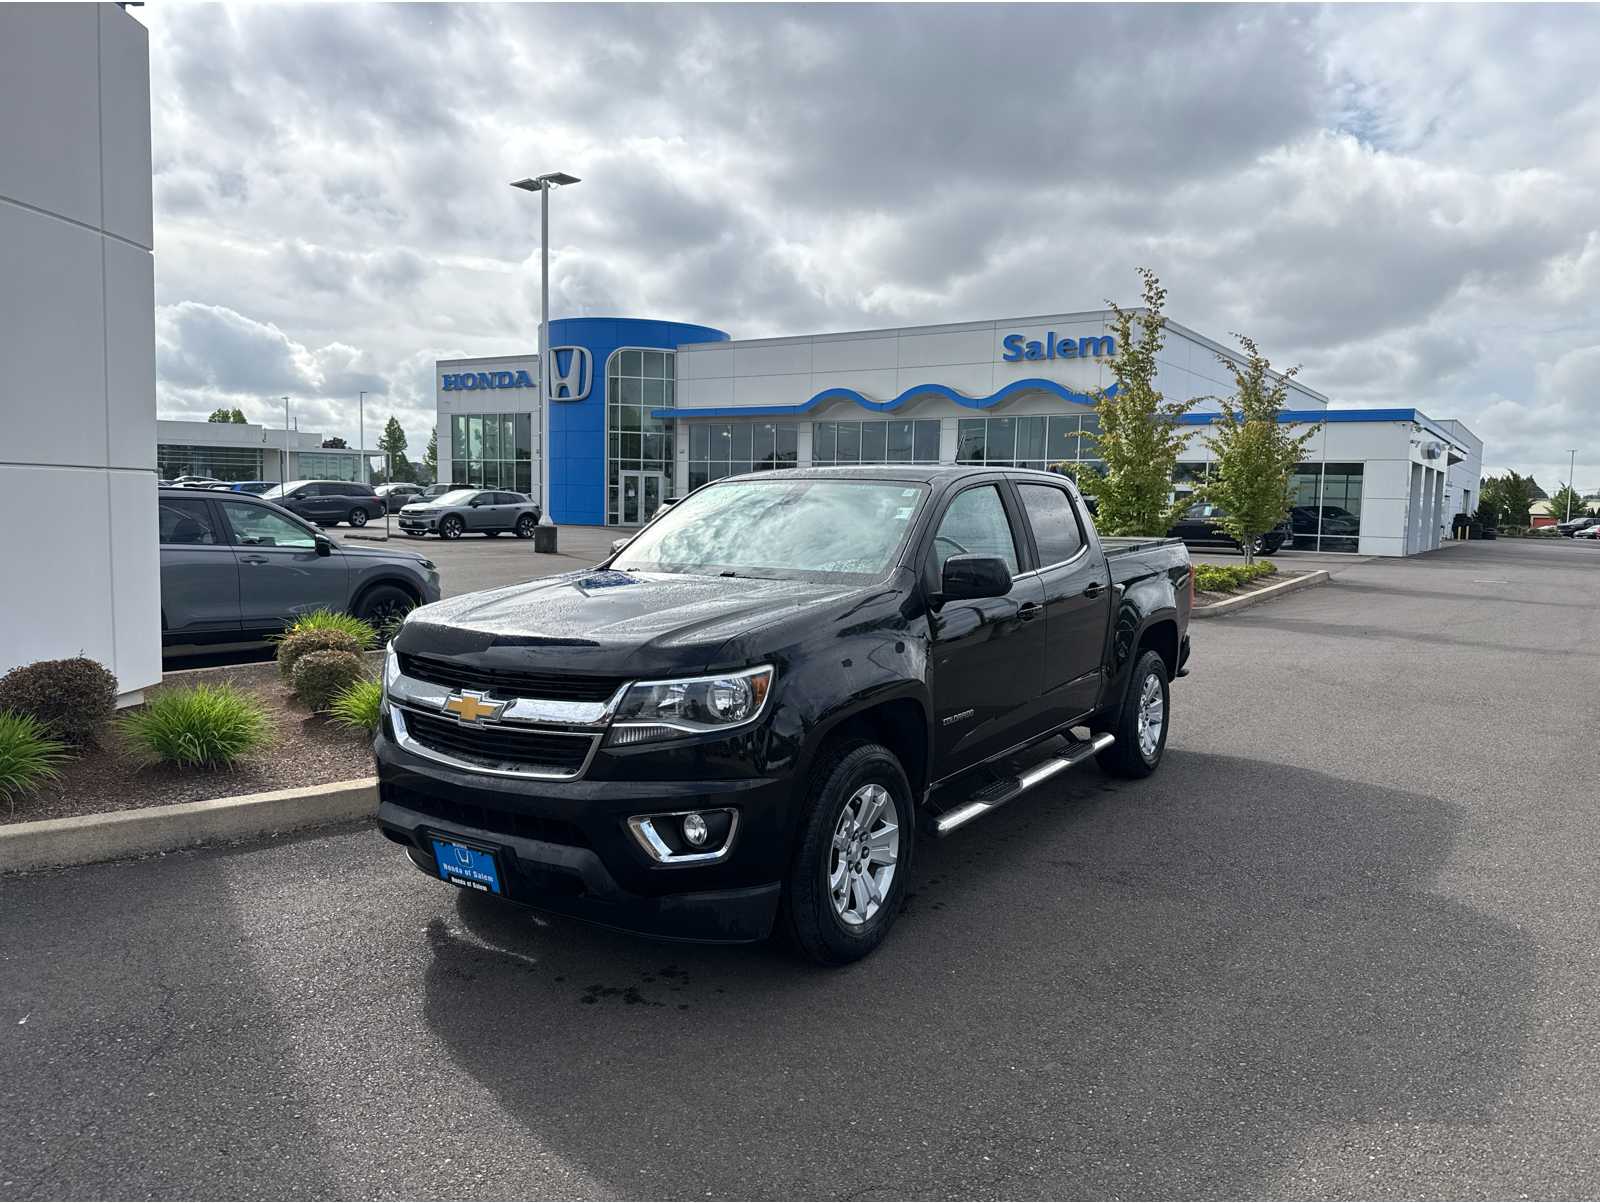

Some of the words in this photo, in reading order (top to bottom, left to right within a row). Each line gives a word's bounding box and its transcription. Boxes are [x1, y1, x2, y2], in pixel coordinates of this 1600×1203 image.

[1003, 331, 1115, 361] Salem
[442, 371, 536, 391] HONDA
[443, 863, 462, 875] Honda
[464, 869, 472, 877] of
[473, 871, 494, 882] Salem
